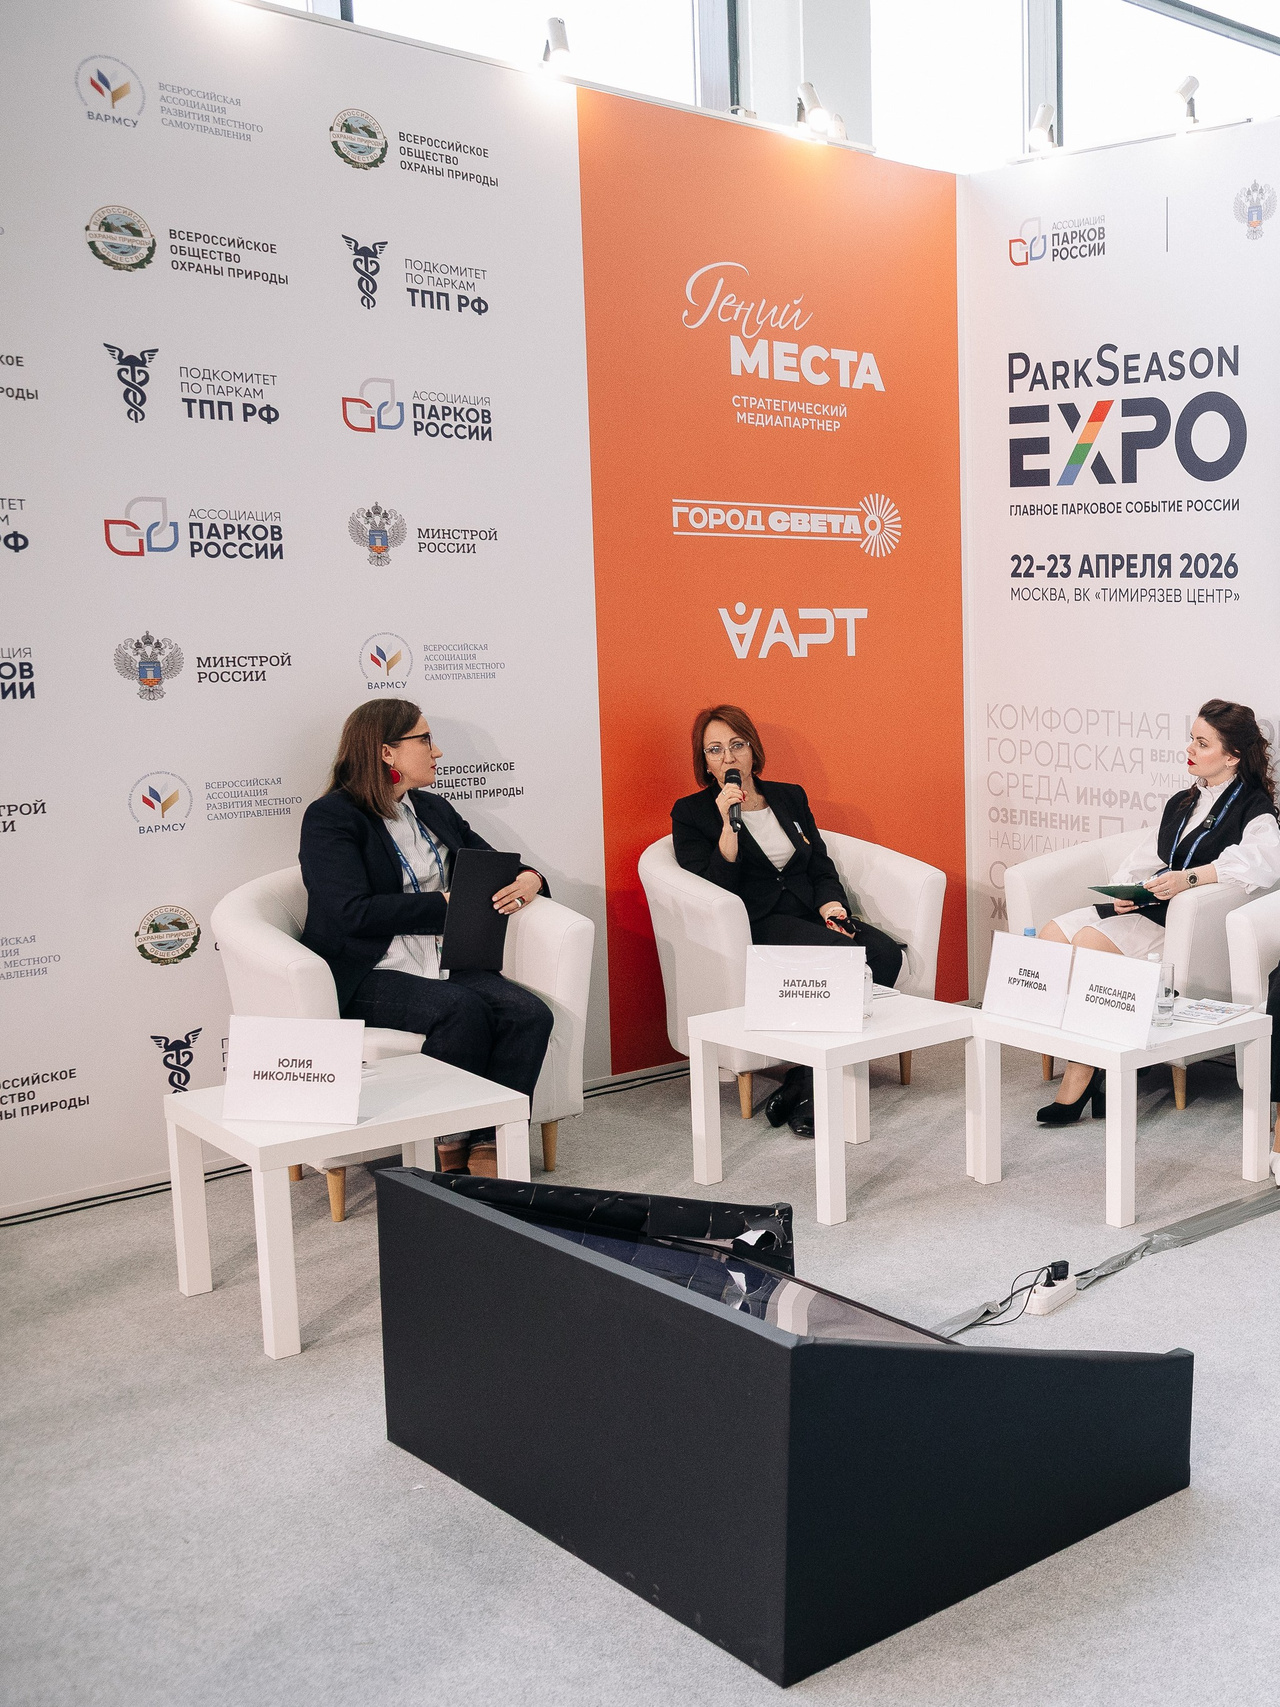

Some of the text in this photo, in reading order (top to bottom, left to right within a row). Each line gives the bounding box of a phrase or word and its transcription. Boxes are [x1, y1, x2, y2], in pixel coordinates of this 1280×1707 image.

[158, 82, 241, 107] ВСЕРОССИЙСКАЯ
[159, 94, 227, 115] АССОЦИАЦИЯ
[87, 110, 139, 129] ВАРМСУ
[160, 106, 264, 133] РАЗВИТИЯ МЕСТНОГО
[161, 117, 252, 142] САМОУПРАВЛЕНИЯ
[399, 131, 489, 159] ВСЕРОССИЙСКОЕ
[399, 146, 459, 166] ОБЩЕСТВО
[400, 160, 499, 187] ОХРАНЫ ПРИРОДЫ
[1052, 215, 1106, 232] АССОЦИАЦИЯ
[169, 228, 277, 254] ВСЕРОССИЙСКОЕ
[1052, 226, 1106, 247] ПАРКОВ
[170, 244, 241, 264] ОБЩЕСТВО
[1052, 242, 1106, 262] РОССИИ
[171, 259, 289, 285] ОХРАНЫ ПРИРОДЫ
[404, 258, 487, 281] ПОДКОМИТЕТ
[405, 272, 476, 292] ПО ПАРКАМ
[406, 287, 489, 316] ТПП РФ
[730, 335, 886, 392] МЕСТА
[179, 366, 278, 386] ПОДКОМИТЕТ
[180, 381, 265, 400] ПО ПАРКАМ
[412, 390, 491, 407] АССОЦИАЦИЯ
[181, 397, 280, 425] ТПП РФ
[412, 403, 492, 424] ПАРКОВ
[731, 394, 847, 418] СТРАТЕГИЧЕСКИЙ
[413, 420, 493, 442] РОССИИ
[736, 411, 841, 432] МЕДИАПАРТНЕР
[1008, 391, 1248, 488] EXPO
[188, 508, 281, 522] АССОЦИАЦИЯ
[1009, 498, 1240, 517] ГЛАВНОЕ ПАРКОВОЕ СОБЫТИЕ РОССИИ
[672, 506, 862, 535] ГОРОД СВЕТА
[188, 522, 283, 541] ПАРКОВ
[417, 527, 498, 541] МИНСТРОЙ
[189, 541, 284, 560] РОССИИ
[417, 542, 477, 554] РОССИИ
[1010, 552, 1239, 579] 22-23 АПРЕЛЯ 2026
[1010, 587, 1240, 605] МОСКВА, ВК «ТИМИРЯЗЕВ ЦЕНТР»
[423, 643, 489, 652] ВСЕРОССИЙСКАЯ
[196, 652, 292, 669] МИНСТРОЙ
[423, 653, 477, 662] АССОЦИАЦИЯ
[424, 662, 506, 672] РАЗВИТИЯ МЕСТНОГО
[197, 670, 267, 684] РОССИИ
[367, 681, 407, 690] ВАРМСУ
[424, 672, 496, 681] САМОУПРАВЛЕНИЯ
[986, 703, 1171, 741] КОМФОРТНАЯ
[987, 736, 1144, 775] ГОРОДСКАЯ
[434, 762, 515, 776] СЕРОССИЙСКОЕ
[205, 777, 282, 790] ВСЕРОССИЙСКАЯ
[430, 777, 487, 789] ОБЩЕСТВО
[475, 786, 524, 799] ПРИРОДЫ
[987, 770, 1070, 806] СРЕДА
[205, 788, 269, 801] АССОЦИАЦИЯ
[206, 796, 303, 811] РАЗВИТИЯ МЕСТНОГО
[207, 807, 292, 821] САМОУПРАВЛЕНИЯ
[988, 806, 1091, 833] ОЗЕЛЕНЕНИЕ
[138, 823, 186, 835] ВАРМСУ
[3, 954, 61, 969] МЕСТНОГО
[782, 978, 827, 988] НАТАЛЬЯ
[1018, 967, 1040, 980] ЕЛЕНА
[778, 989, 831, 999] ЗИНЧЕНКО
[1007, 976, 1047, 993] КРУТИКОВА
[1088, 983, 1136, 1002] АЛЕКСАНДРА
[1084, 993, 1136, 1013] БОГОМОЛОВА
[277, 1058, 313, 1069] ЮЛИЯ
[252, 1070, 336, 1083] НИКОЛЬЧЕНКО
[21, 1095, 90, 1118] ПРИРОДЫ
